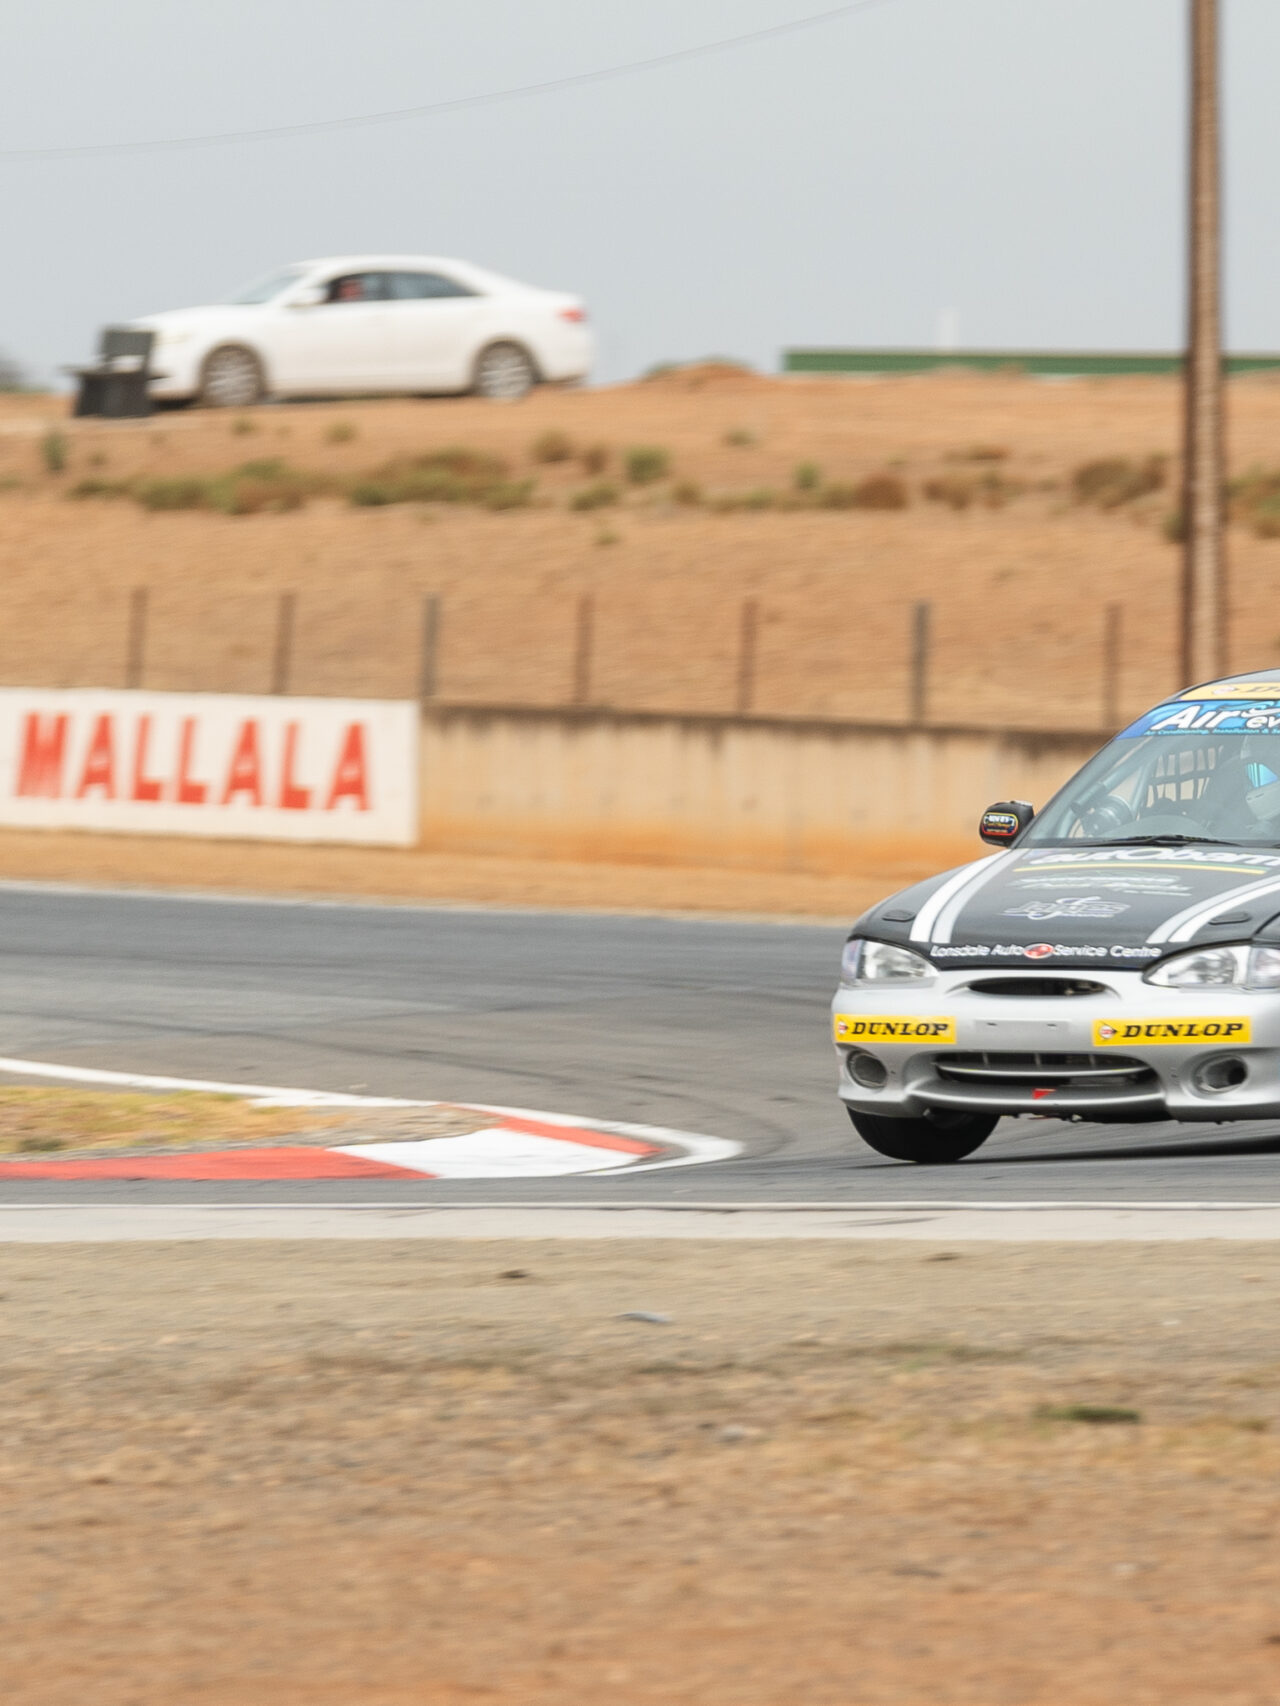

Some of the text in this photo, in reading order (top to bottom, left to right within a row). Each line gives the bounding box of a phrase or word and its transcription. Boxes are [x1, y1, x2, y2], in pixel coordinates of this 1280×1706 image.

[1150, 705, 1241, 731] Air
[15, 711, 371, 812] MALLALA
[930, 944, 1163, 958] Lonsdale Auto Service Centre
[851, 1021, 949, 1036] DUNLOP
[1121, 1023, 1244, 1038] DUNLOP
